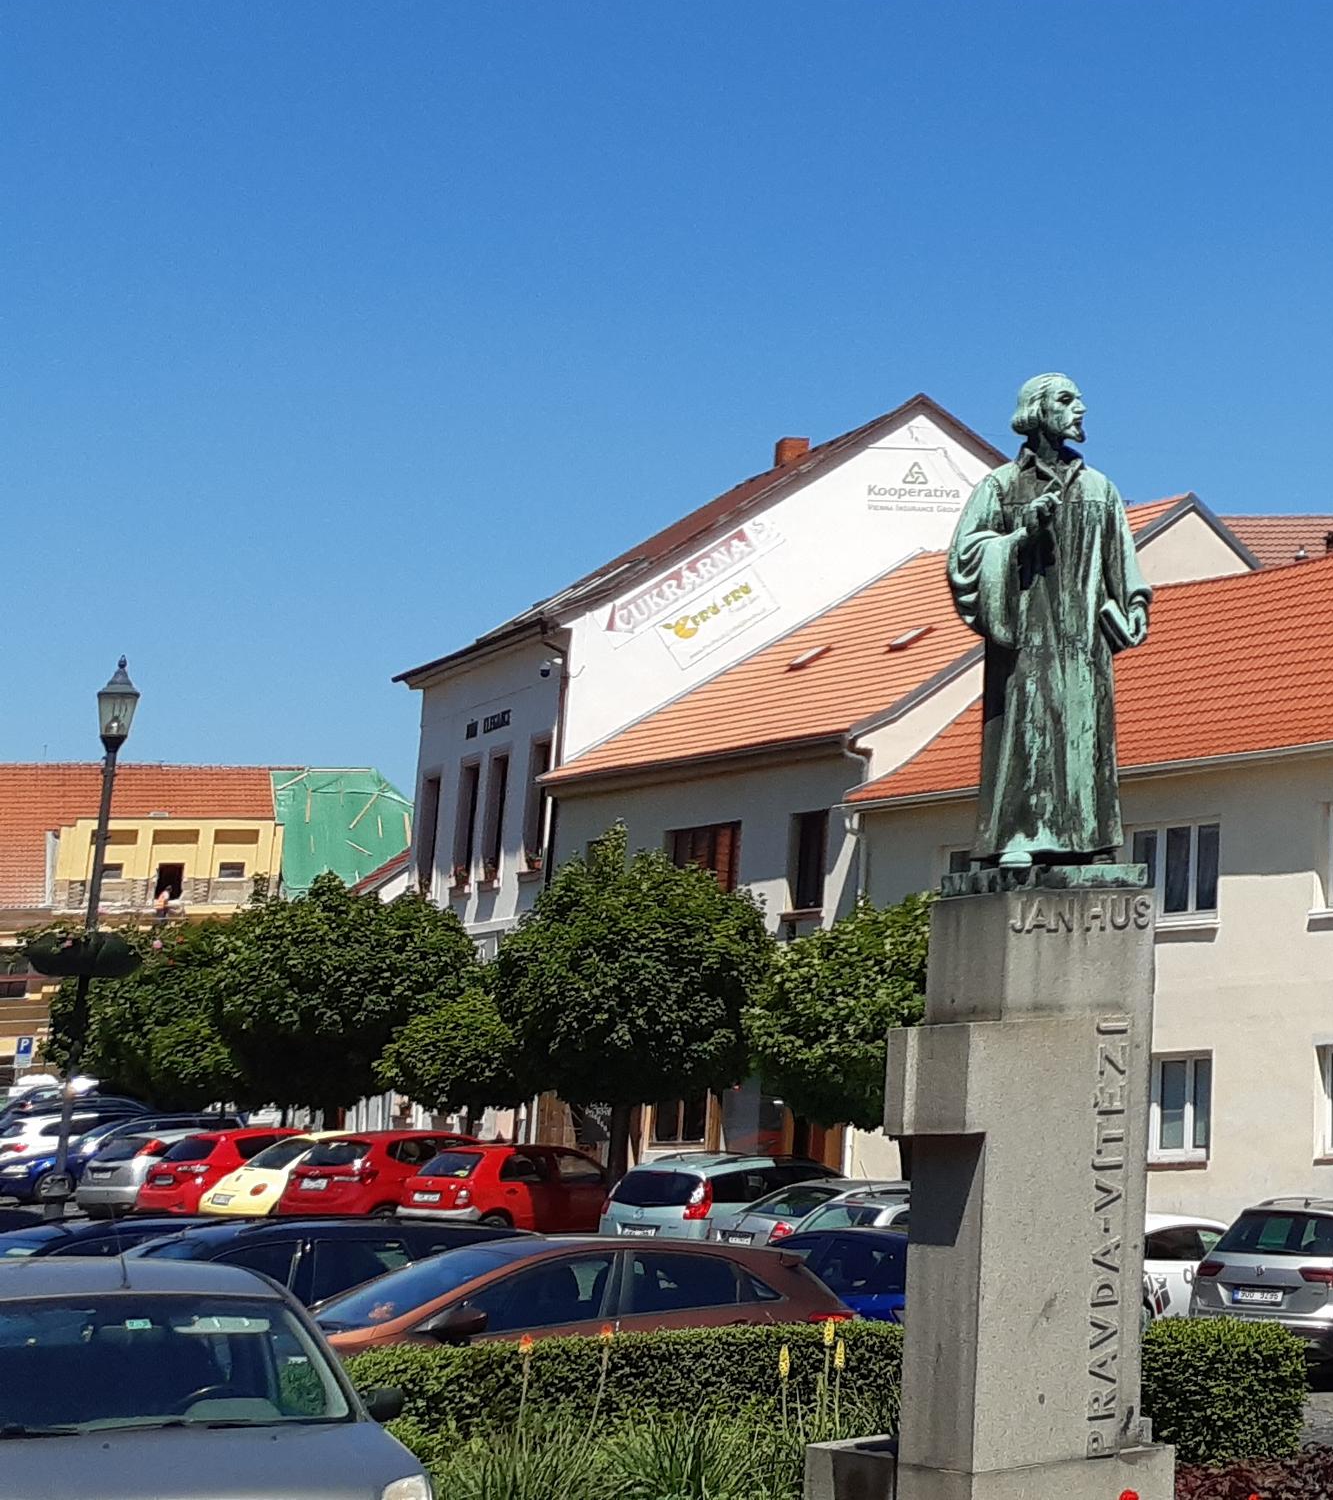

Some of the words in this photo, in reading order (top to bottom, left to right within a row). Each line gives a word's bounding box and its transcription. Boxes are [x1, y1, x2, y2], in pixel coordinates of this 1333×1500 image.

[867, 485, 961, 499] Kooperativa
[617, 538, 753, 630] CUKRÁRNA
[1009, 896, 1076, 934] JAN
[1083, 894, 1151, 931] HUS
[20, 1038, 30, 1052] P
